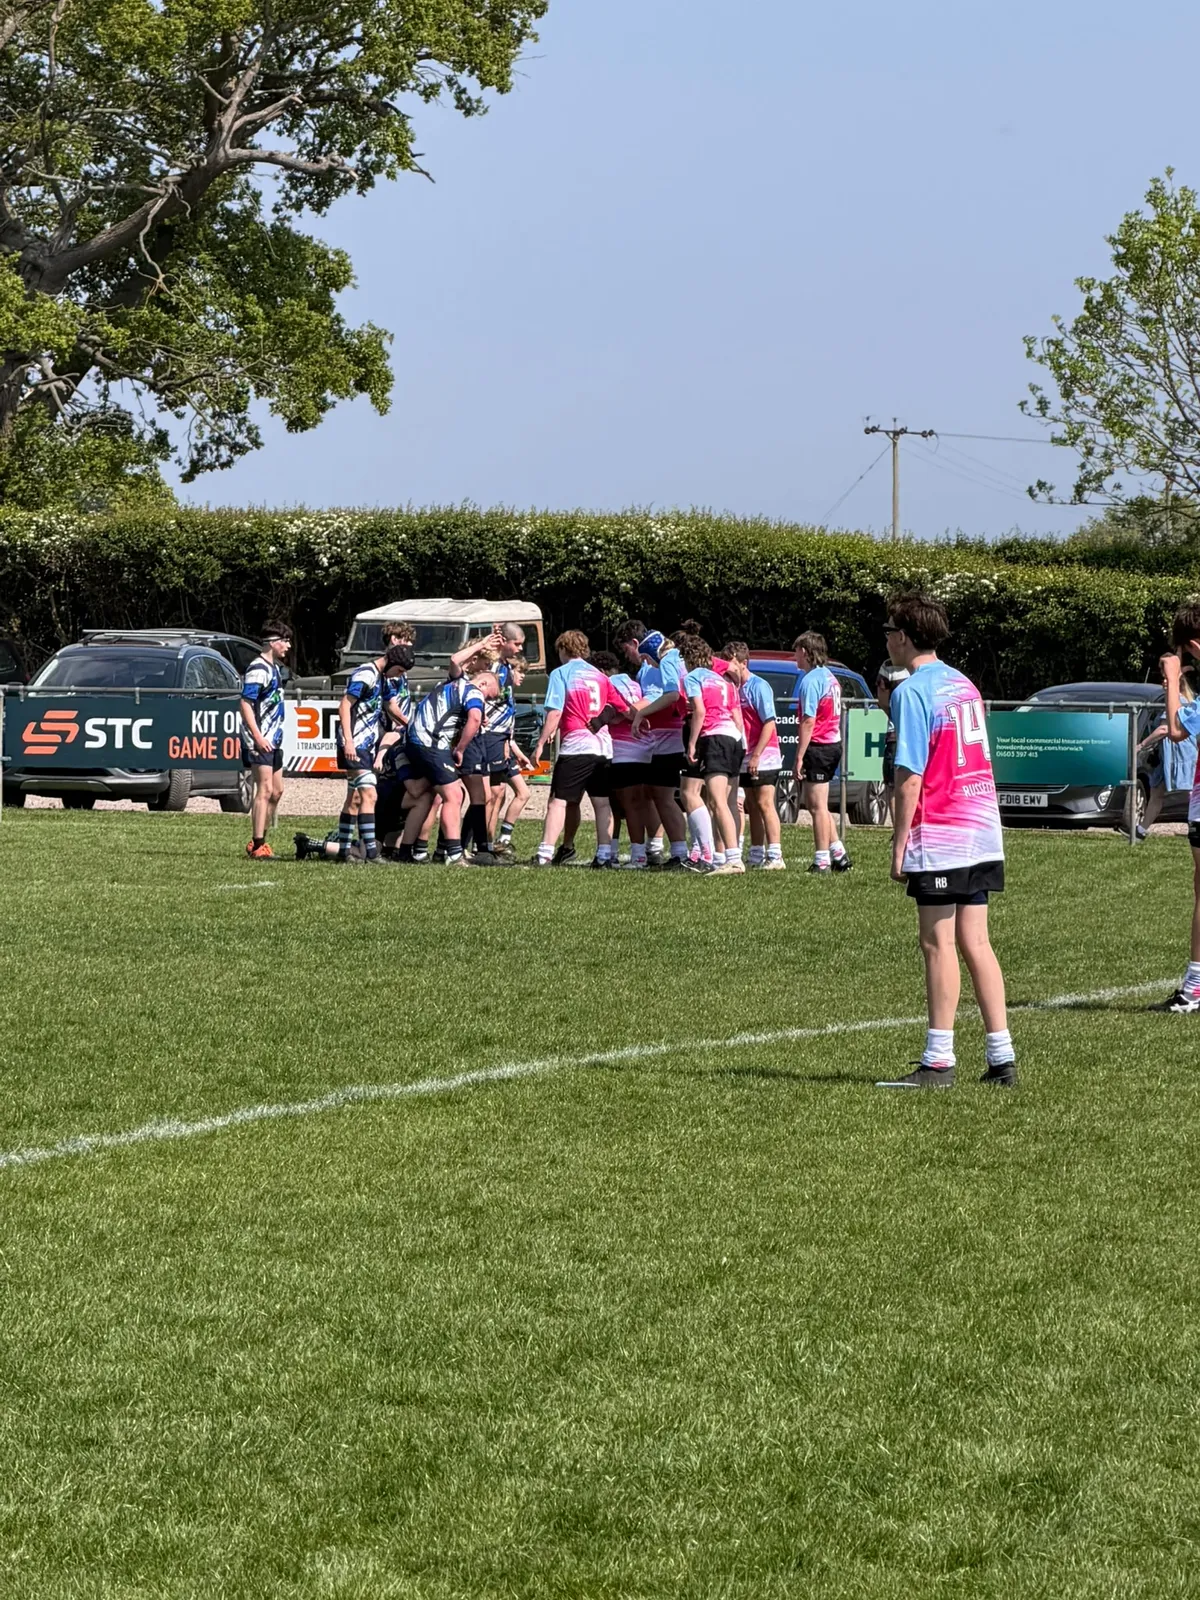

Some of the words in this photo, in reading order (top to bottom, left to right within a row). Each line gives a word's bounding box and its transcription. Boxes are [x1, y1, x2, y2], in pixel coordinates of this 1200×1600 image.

[585, 680, 600, 712] 3
[715, 679, 728, 706] 7
[85, 718, 153, 749] STC
[191, 710, 219, 733] KIT
[946, 700, 990, 767] 14
[168, 736, 218, 759] GAME
[1000, 795, 1021, 804] FD18
[935, 877, 948, 889] RB
